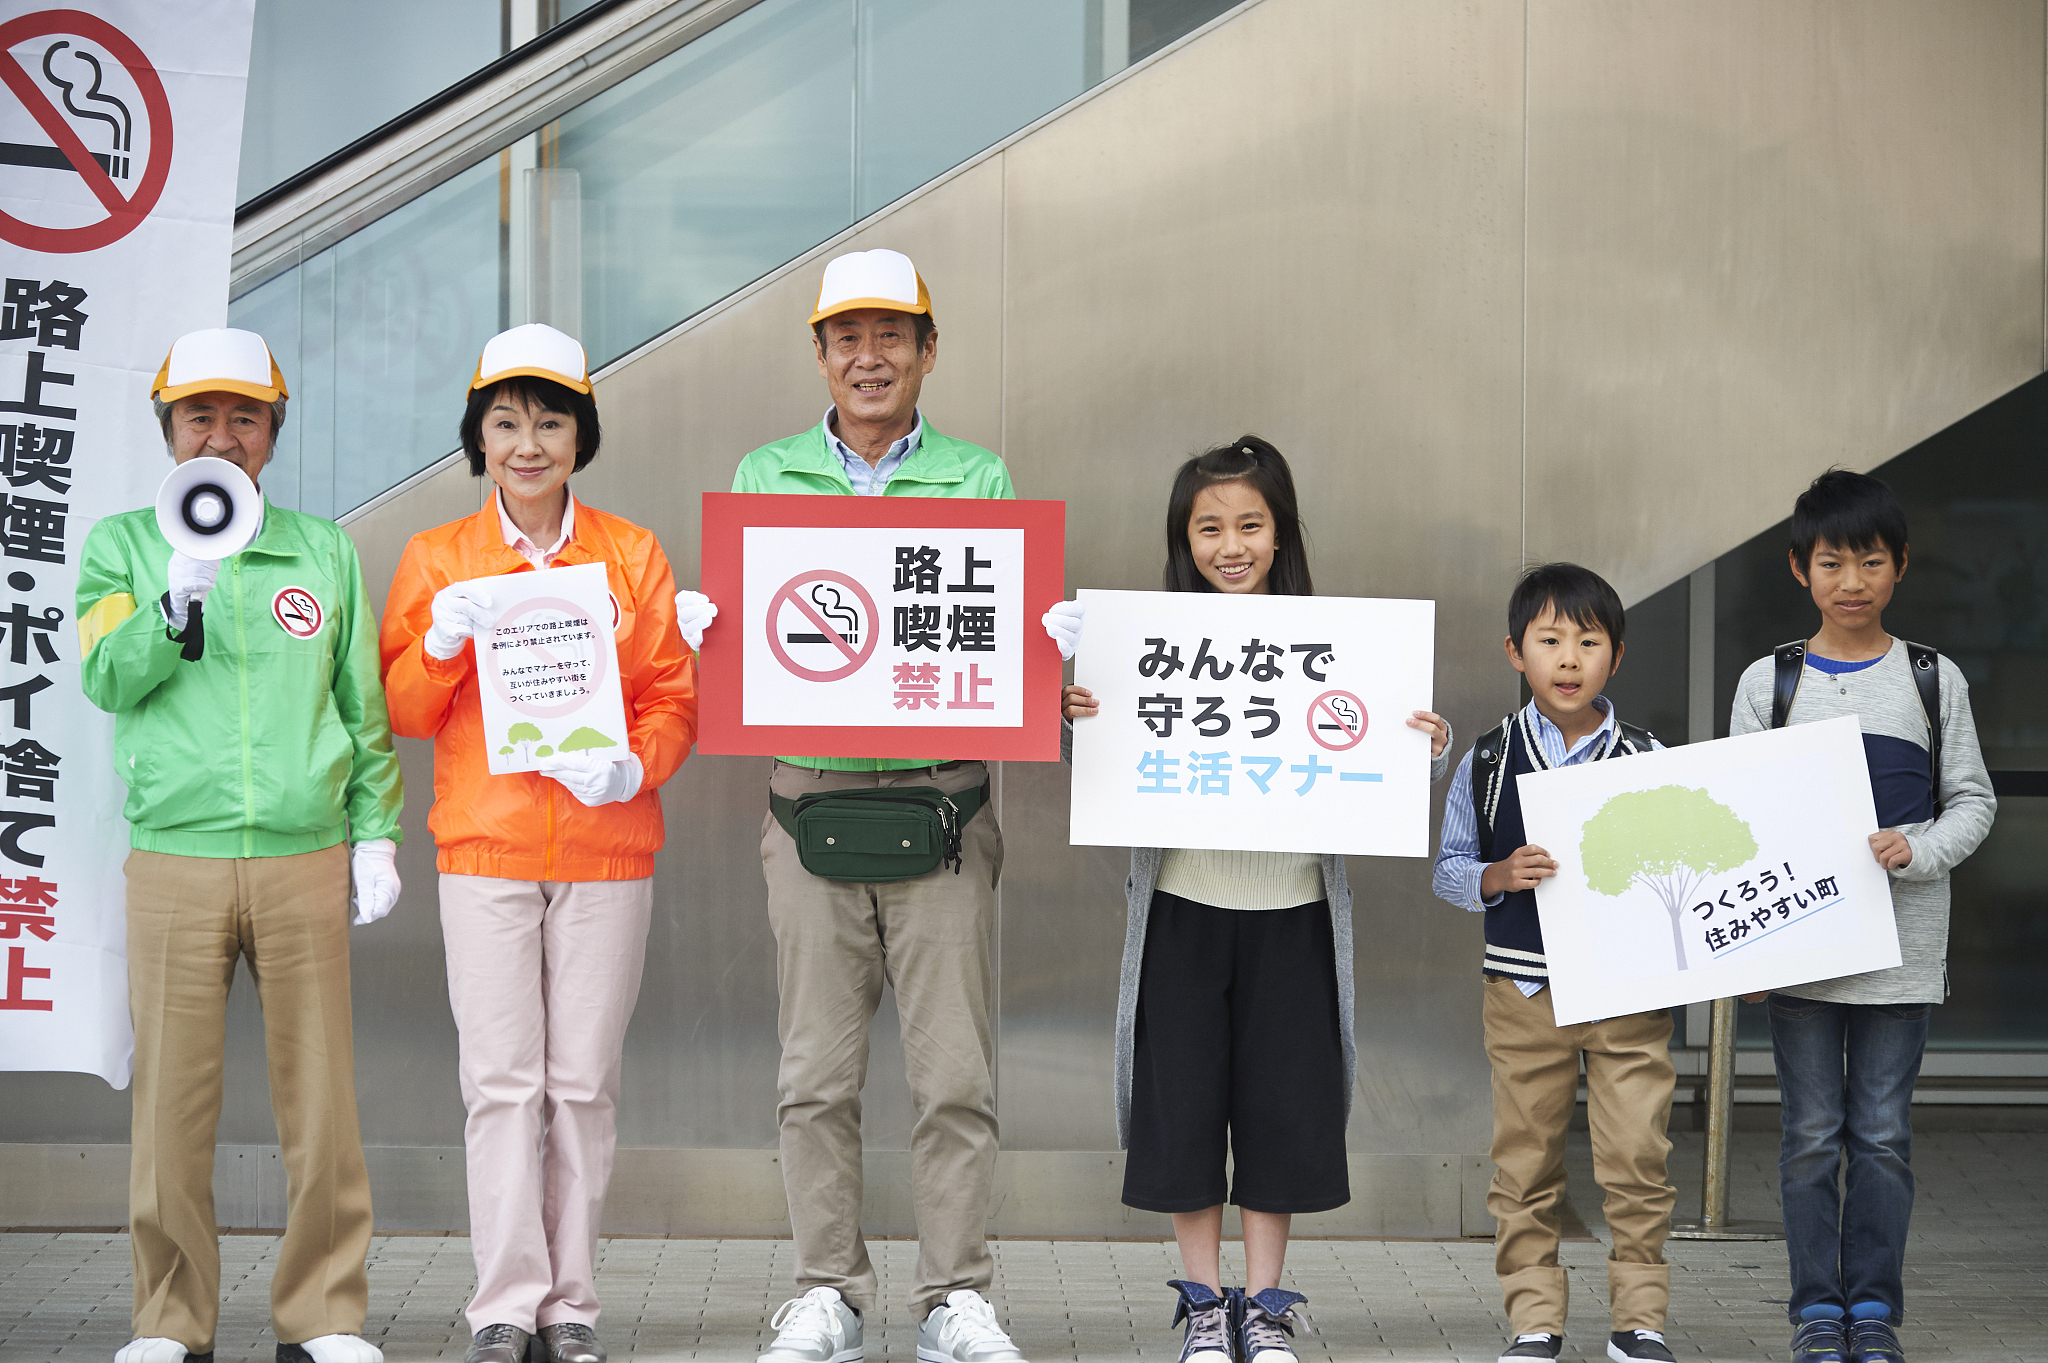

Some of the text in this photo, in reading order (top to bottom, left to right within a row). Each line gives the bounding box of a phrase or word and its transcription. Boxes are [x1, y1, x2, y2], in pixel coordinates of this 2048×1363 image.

[893, 545, 995, 594] 路上
[491, 631, 596, 650] 条例により禁止されています。
[495, 618, 588, 636] このエリアでの路上喫煙は
[893, 604, 996, 652] 喫煙
[502, 659, 591, 677] みんなでマナーを守って、
[509, 673, 587, 690] 互いが住みやすい街を
[1138, 637, 1335, 682] みんなで
[509, 686, 590, 703] つくっていきましょう。
[892, 662, 995, 711] 禁止
[1137, 693, 1281, 739] 守ろう
[1136, 749, 1383, 798] 生活マナー
[1705, 875, 1840, 952] 住みやすい町
